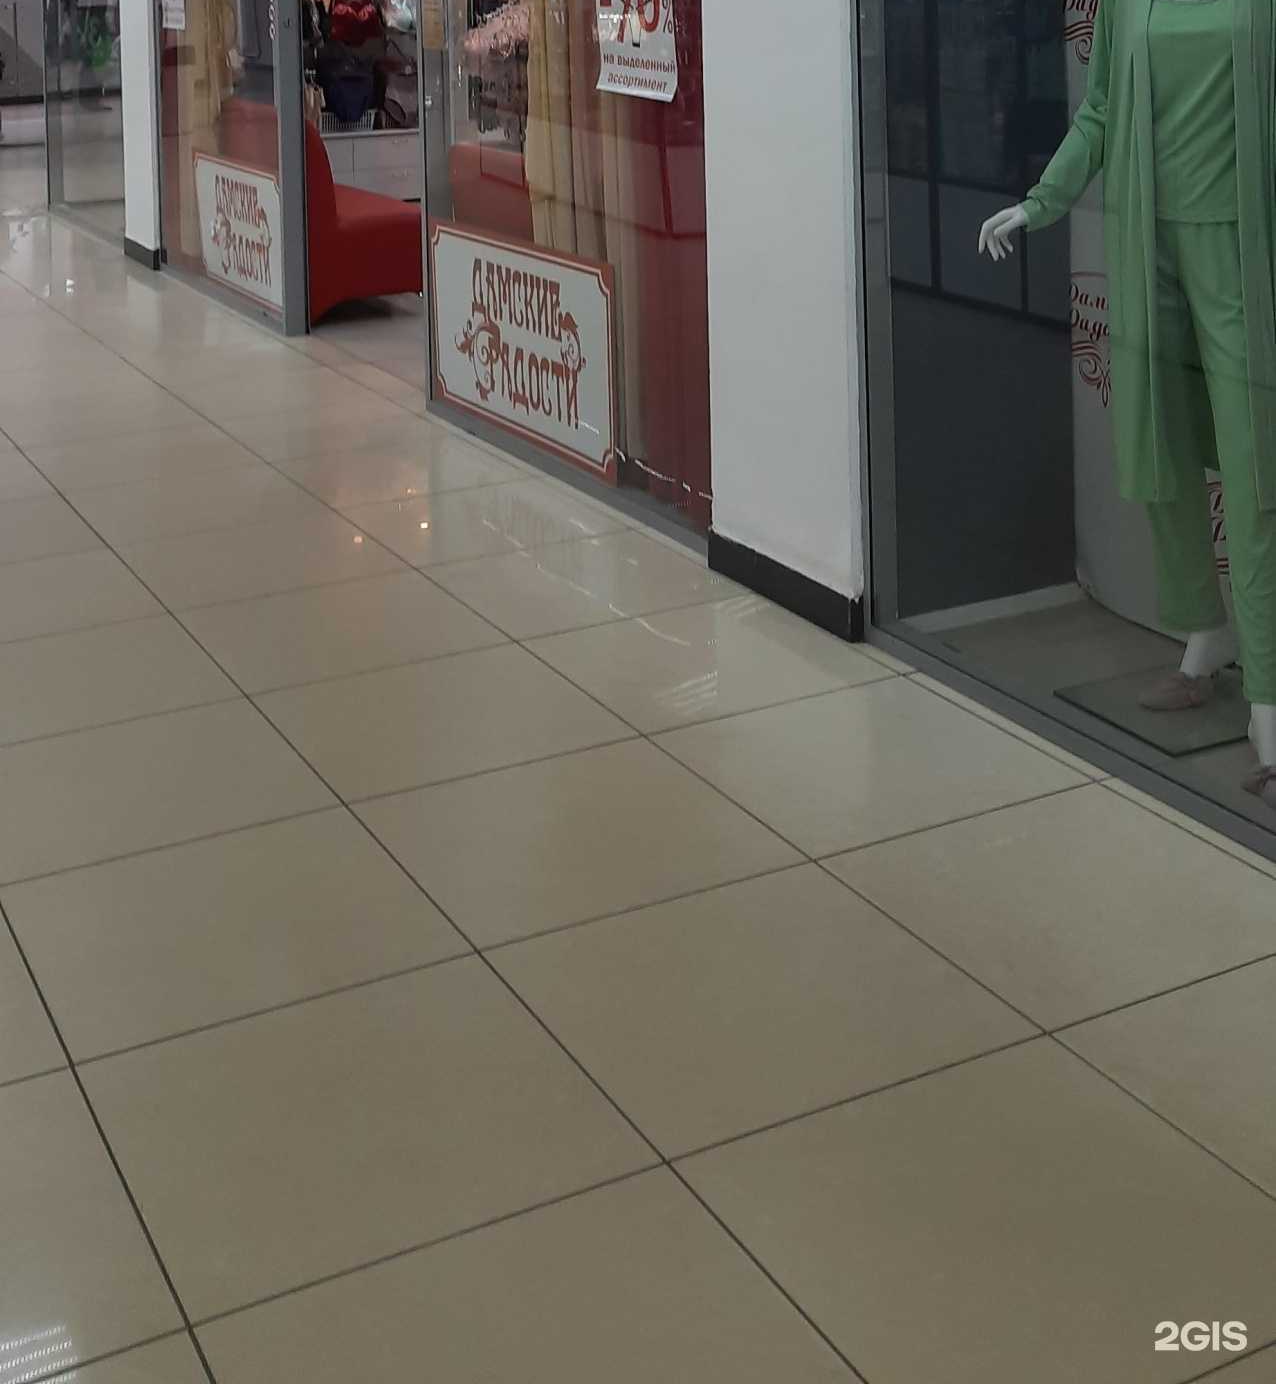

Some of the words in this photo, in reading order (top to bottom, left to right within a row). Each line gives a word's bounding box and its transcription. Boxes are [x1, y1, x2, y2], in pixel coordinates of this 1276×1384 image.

[603, 53, 615, 65] на
[617, 55, 676, 74] выделенный
[607, 72, 668, 93] ассортимент
[472, 258, 563, 342] ДАМСКИЕ
[471, 320, 580, 430] РАДОСТИ
